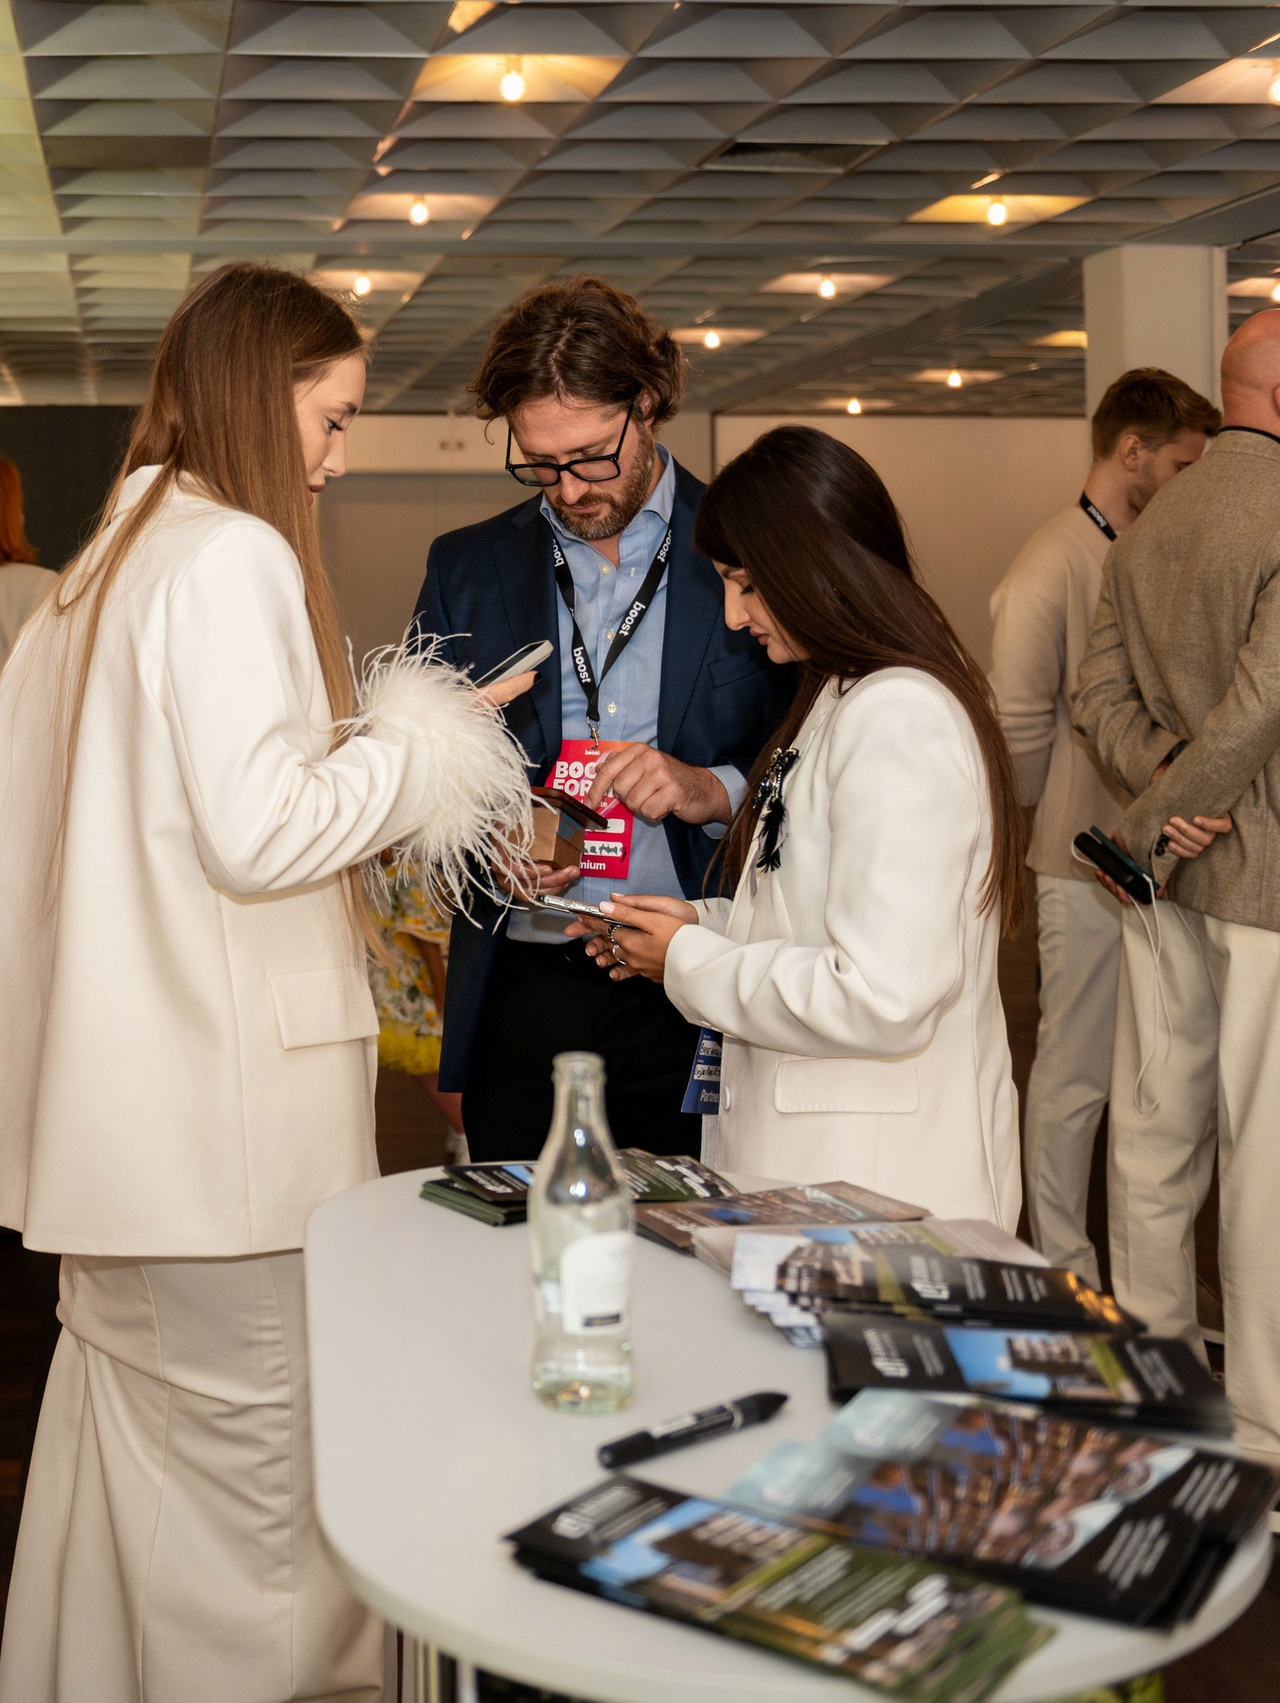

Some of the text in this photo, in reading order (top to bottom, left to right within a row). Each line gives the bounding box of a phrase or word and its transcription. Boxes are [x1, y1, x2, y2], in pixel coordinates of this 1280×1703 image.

[657, 530, 672, 562] oost
[619, 600, 646, 637] boost
[573, 646, 591, 684] boost
